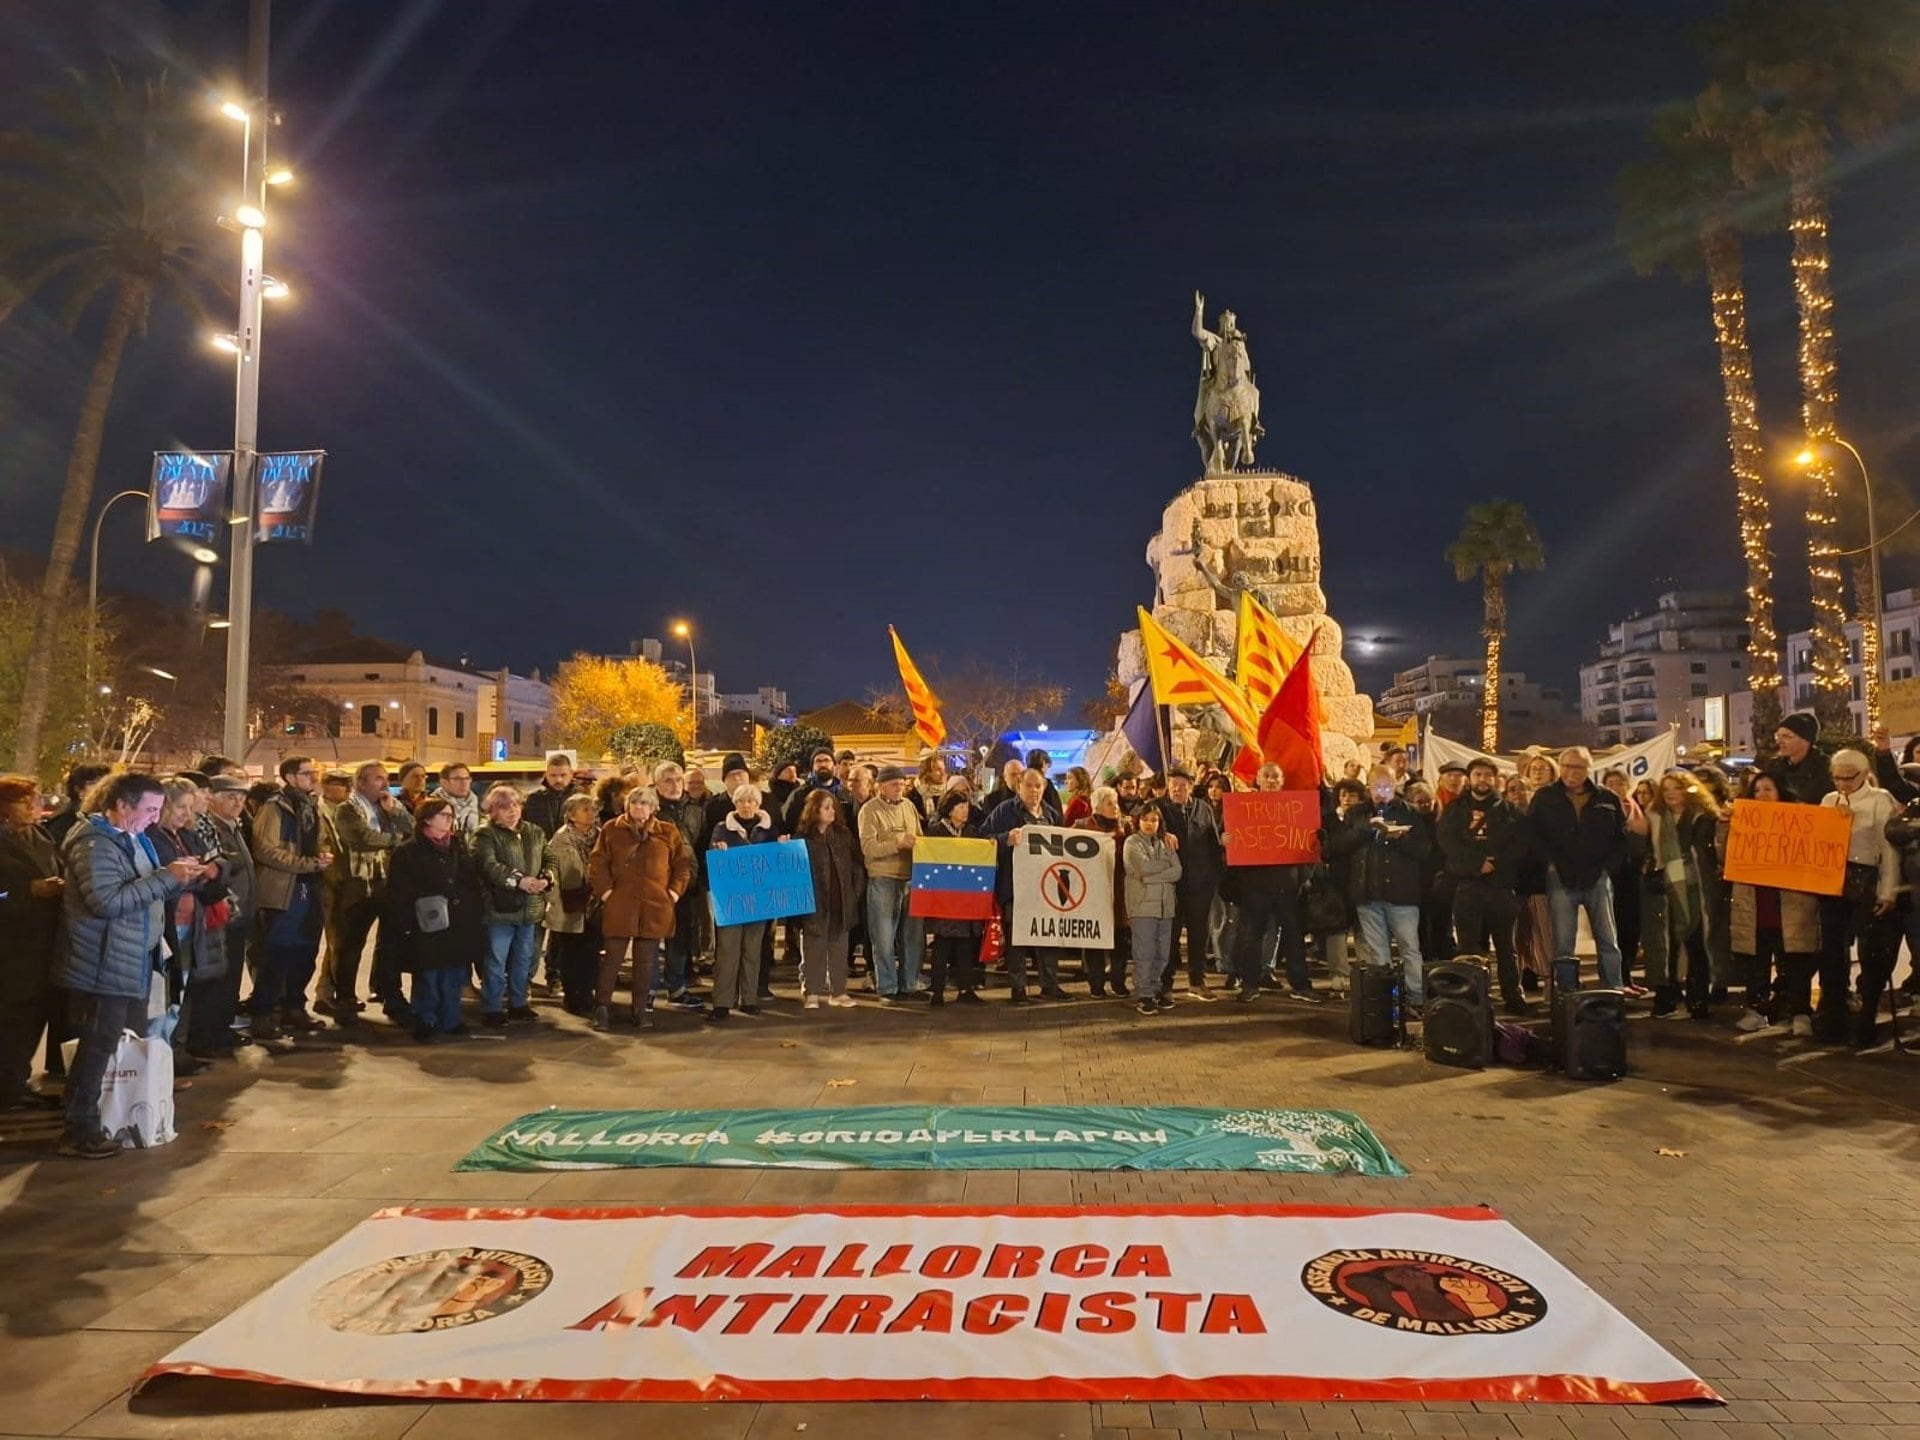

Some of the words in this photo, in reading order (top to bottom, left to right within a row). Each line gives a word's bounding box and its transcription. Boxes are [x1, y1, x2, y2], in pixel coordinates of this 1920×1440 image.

[1240, 801, 1303, 823] TRUMP
[1741, 806, 1762, 829] NO
[1769, 810, 1815, 835] MAS
[1028, 833, 1100, 859] NO
[1729, 831, 1846, 871] IMPERIALISMO
[1030, 917, 1039, 937] A
[1041, 918, 1056, 937] LA
[1058, 918, 1101, 939] GUERRA
[496, 1130, 729, 1146] MALLORCA
[673, 1242, 1171, 1279] MALLORCA
[1380, 1249, 1531, 1293] ANTIRACISTA
[562, 1287, 1268, 1335] ANTIRACISTA
[1352, 1308, 1395, 1326] DE
[1397, 1310, 1537, 1335] MALLORCA
